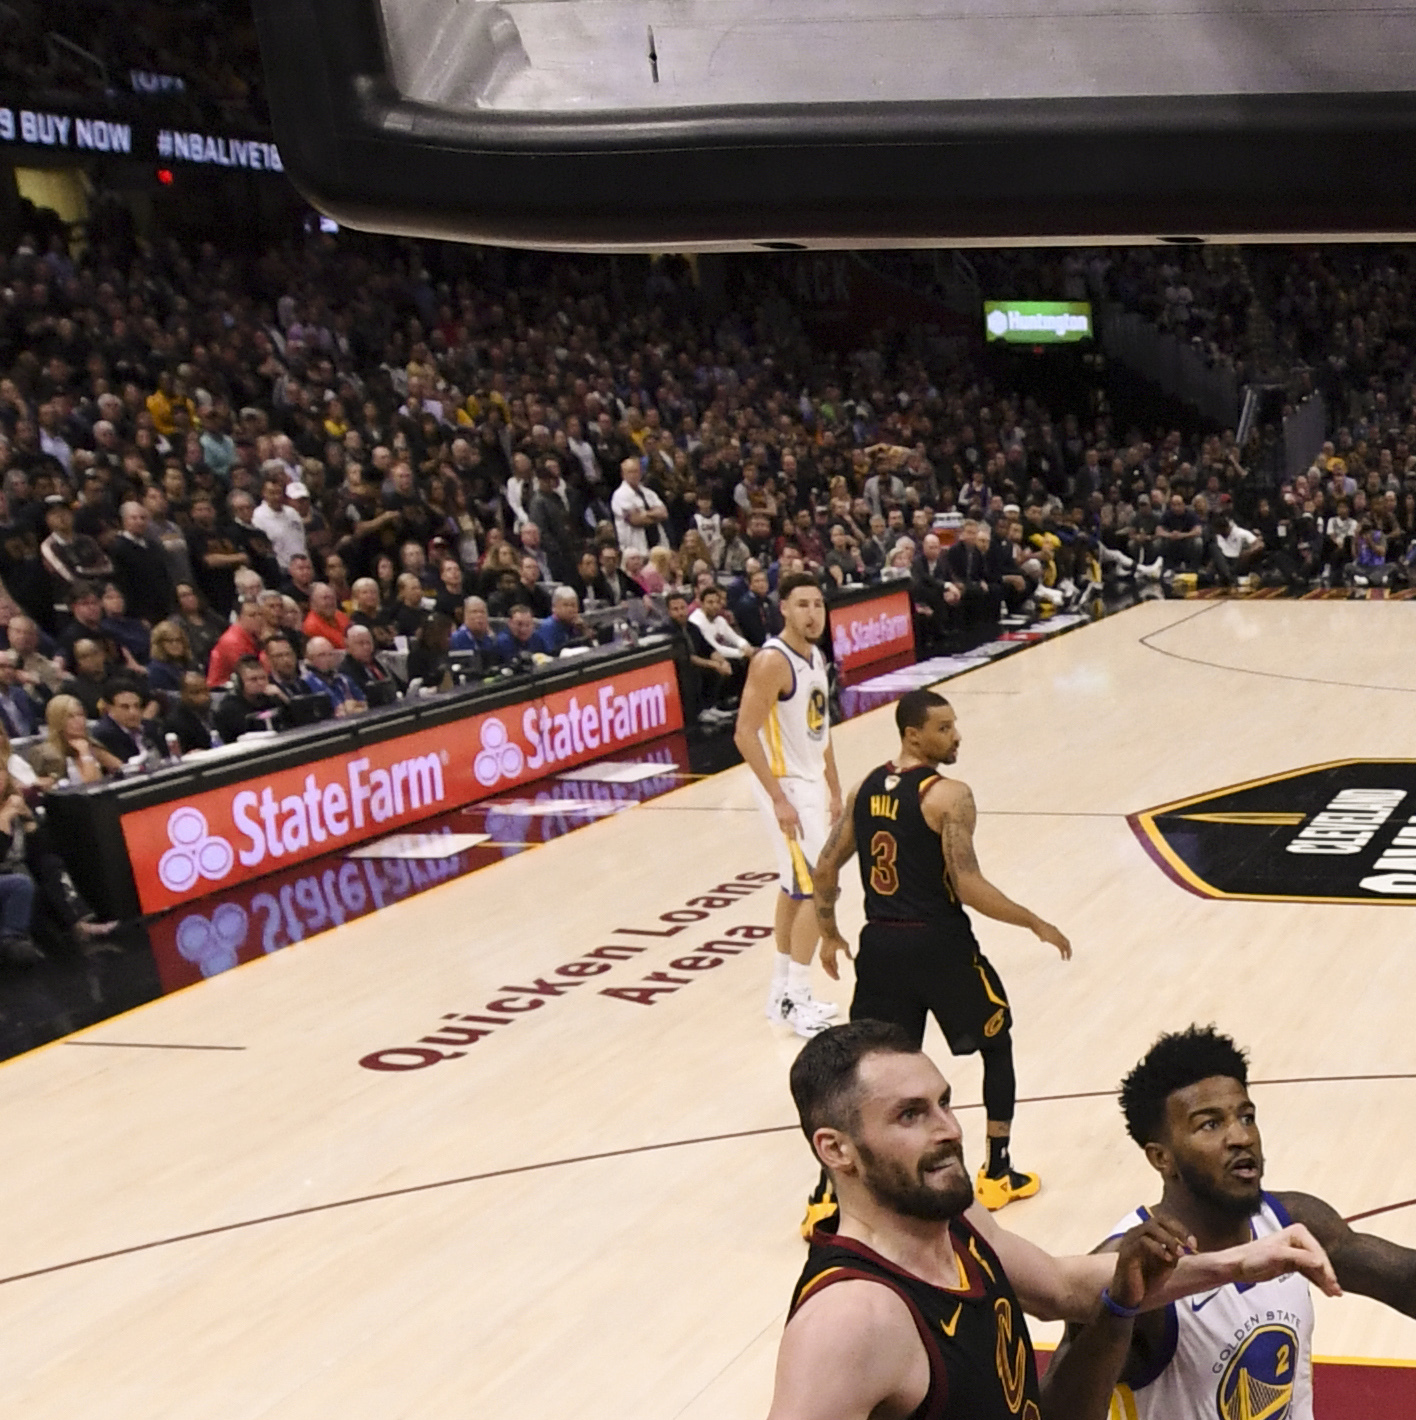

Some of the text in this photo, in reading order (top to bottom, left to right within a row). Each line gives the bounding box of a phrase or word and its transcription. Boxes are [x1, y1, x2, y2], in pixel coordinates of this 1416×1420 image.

[19, 110, 70, 145] BUY
[75, 118, 131, 153] NOW
[870, 795, 900, 821] HILL
[1286, 788, 1408, 855] CLEVELAND
[869, 830, 899, 896] 3
[358, 870, 781, 1072] Quicken Loans
[597, 923, 776, 1006] Arena
[1211, 1313, 1260, 1374] GOLDEN
[1276, 1344, 1290, 1377] 2
